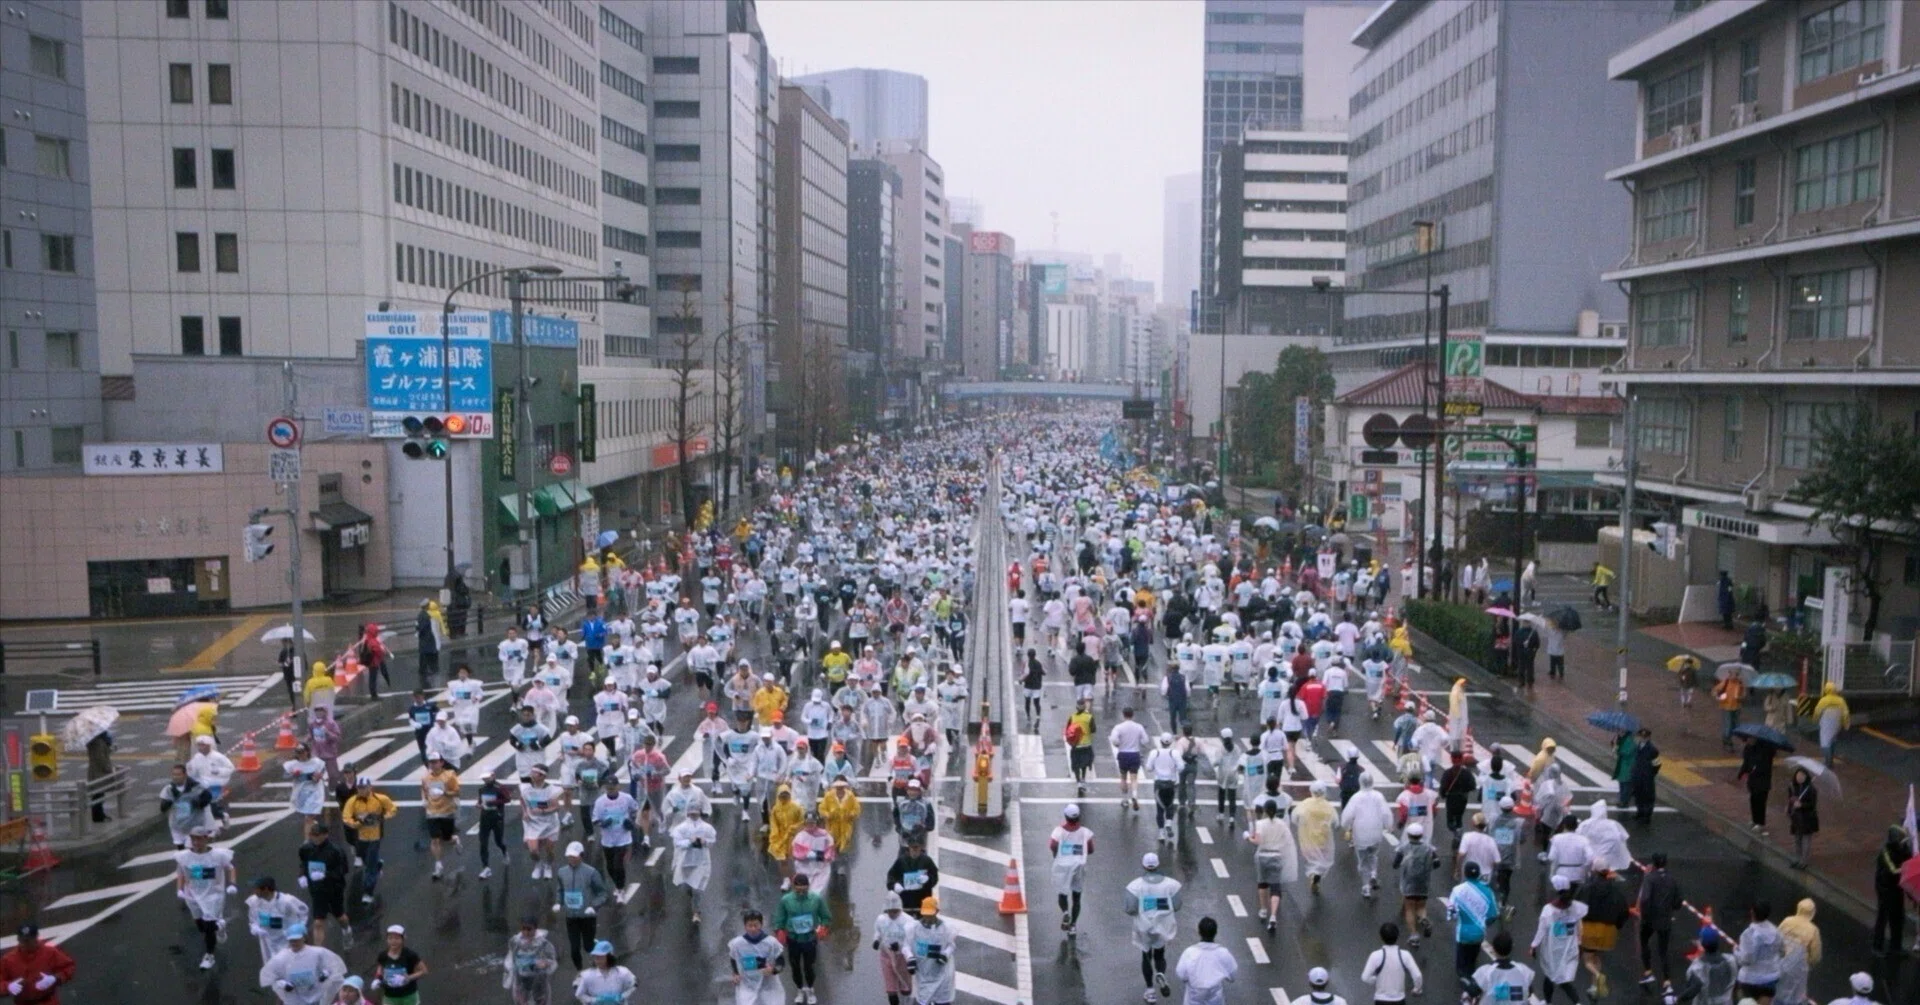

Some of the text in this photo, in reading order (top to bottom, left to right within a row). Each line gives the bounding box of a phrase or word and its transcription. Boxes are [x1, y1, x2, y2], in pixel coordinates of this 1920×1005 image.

[388, 325, 416, 336] GOLF
[372, 343, 484, 370] 霞ヶ浦国際
[380, 374, 476, 391] ゴルフコース
[326, 412, 364, 425] 札の辻
